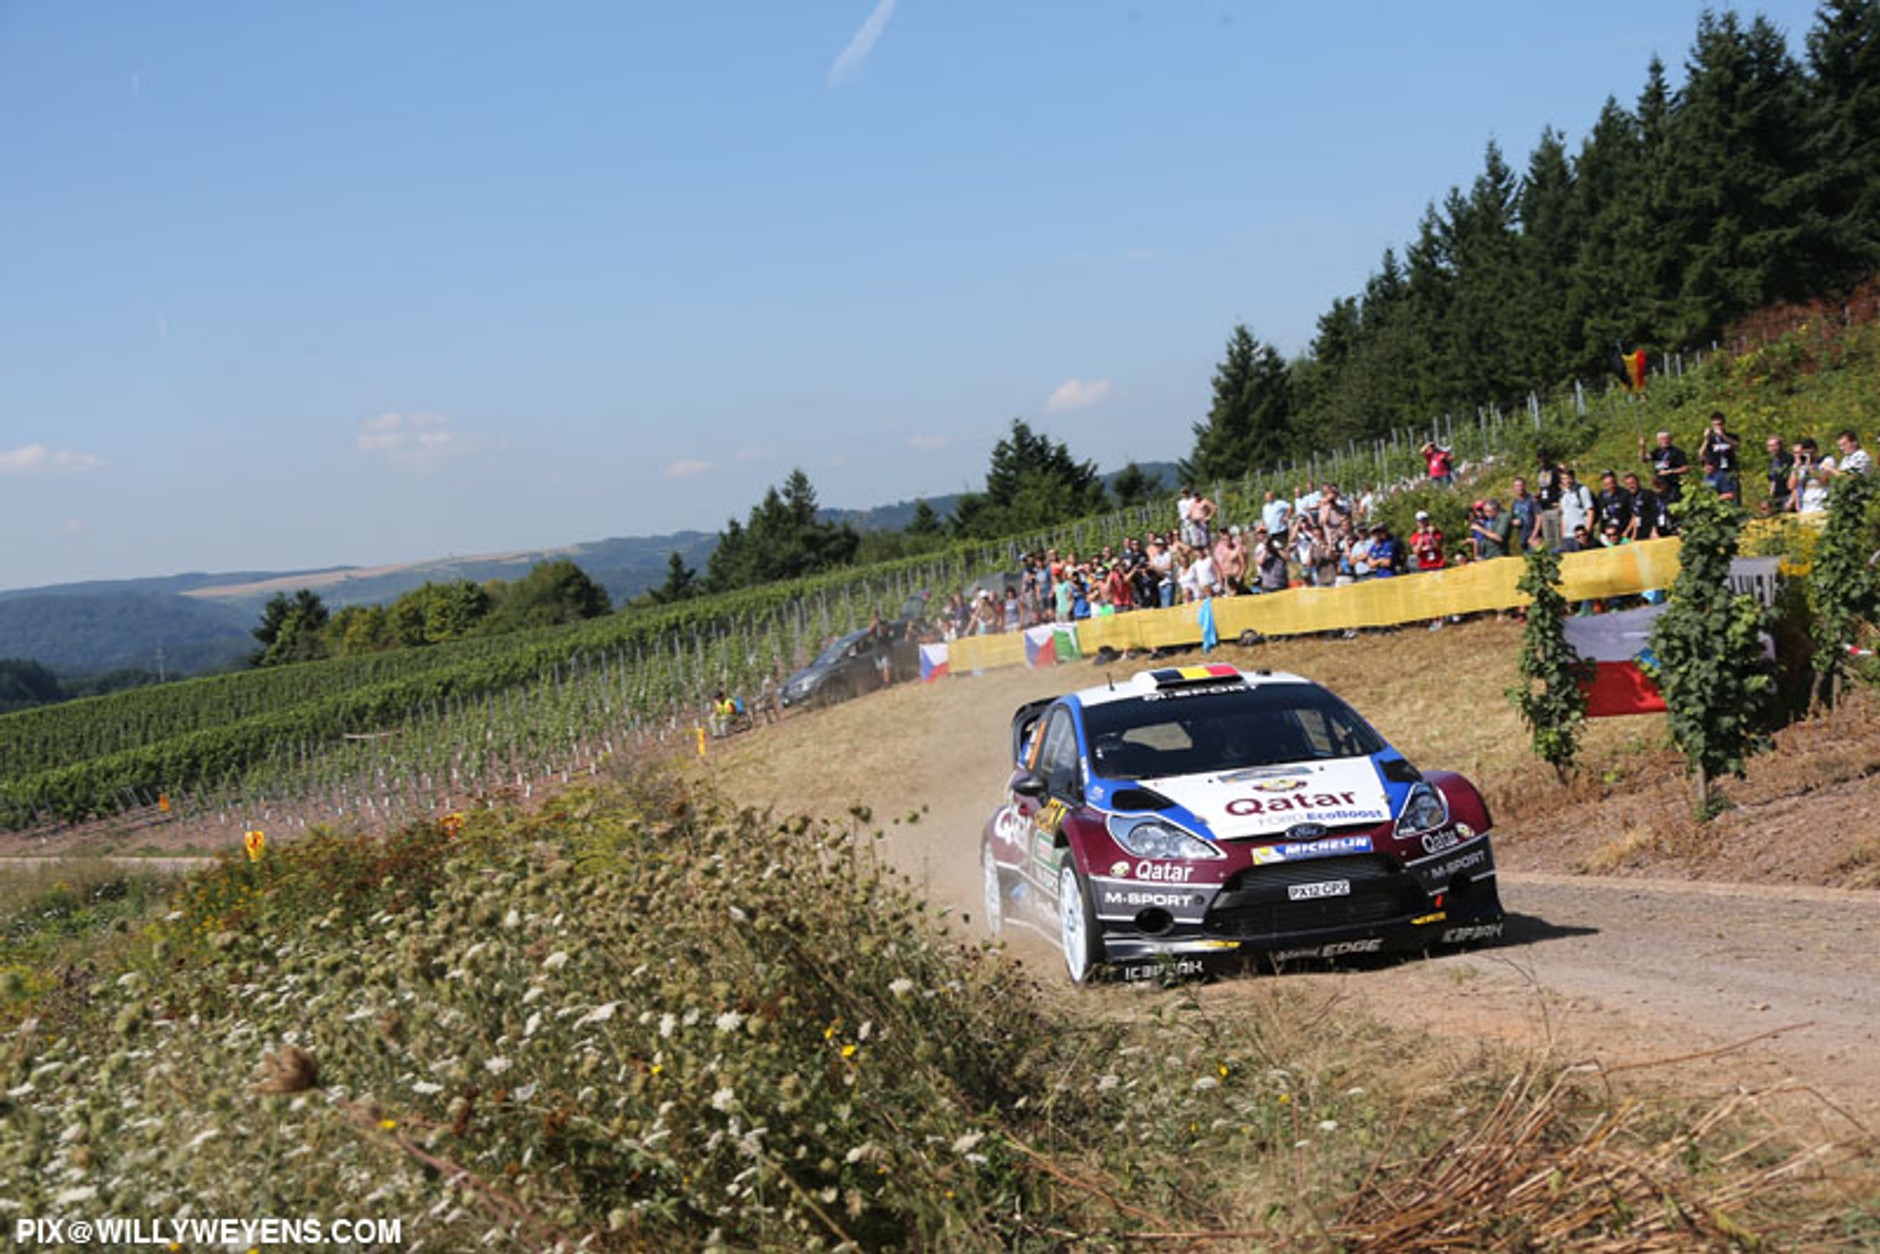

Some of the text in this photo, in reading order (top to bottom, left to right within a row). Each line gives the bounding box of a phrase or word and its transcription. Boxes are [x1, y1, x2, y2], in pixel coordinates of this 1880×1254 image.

[1225, 791, 1355, 816] Qatar
[1306, 809, 1383, 820] EcoBoost
[1285, 837, 1368, 854] MICHELIN
[1422, 829, 1459, 853] Qatar
[1135, 860, 1195, 882] Qatar
[1431, 849, 1485, 879] M-SPORT
[1104, 891, 1193, 907] M-SPORT
[1322, 938, 1383, 957] EDGE
